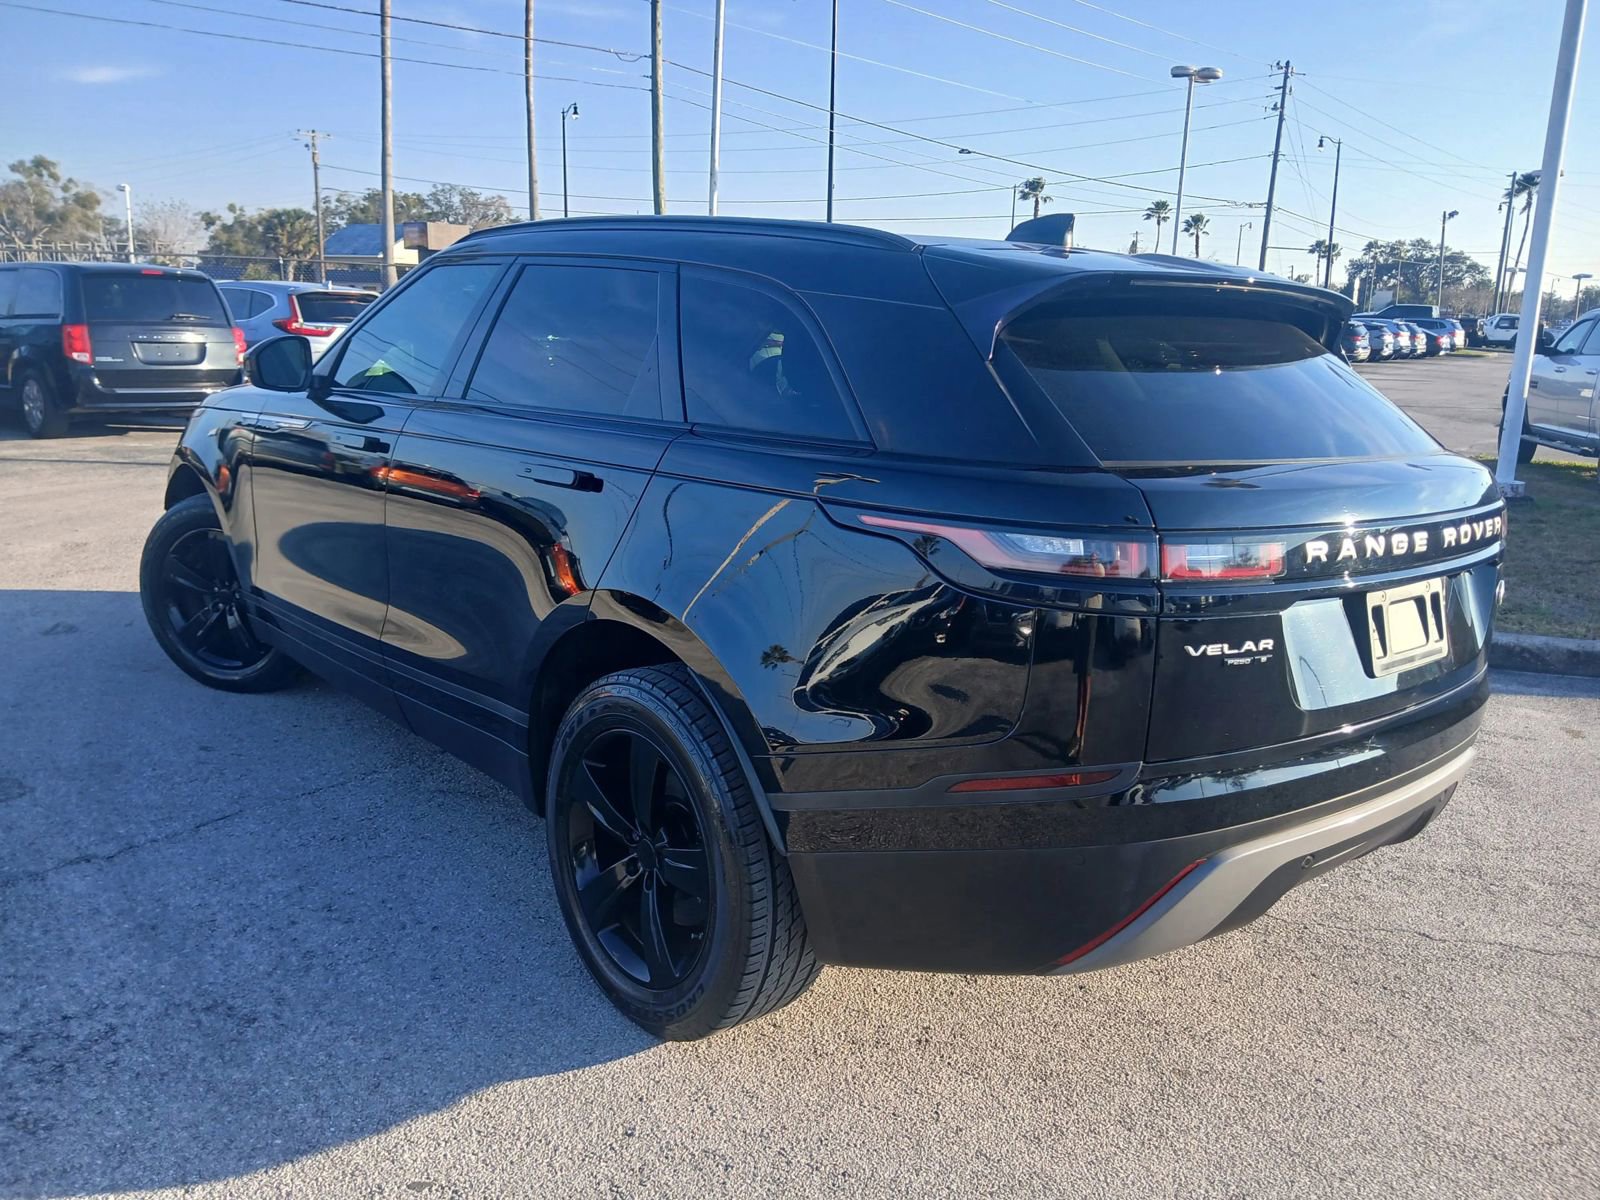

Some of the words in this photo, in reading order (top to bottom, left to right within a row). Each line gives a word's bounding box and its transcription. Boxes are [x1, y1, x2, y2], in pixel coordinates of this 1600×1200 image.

[1304, 531, 1429, 564] RANGE
[1442, 516, 1502, 549] ROVER
[1184, 638, 1274, 657] VELAR
